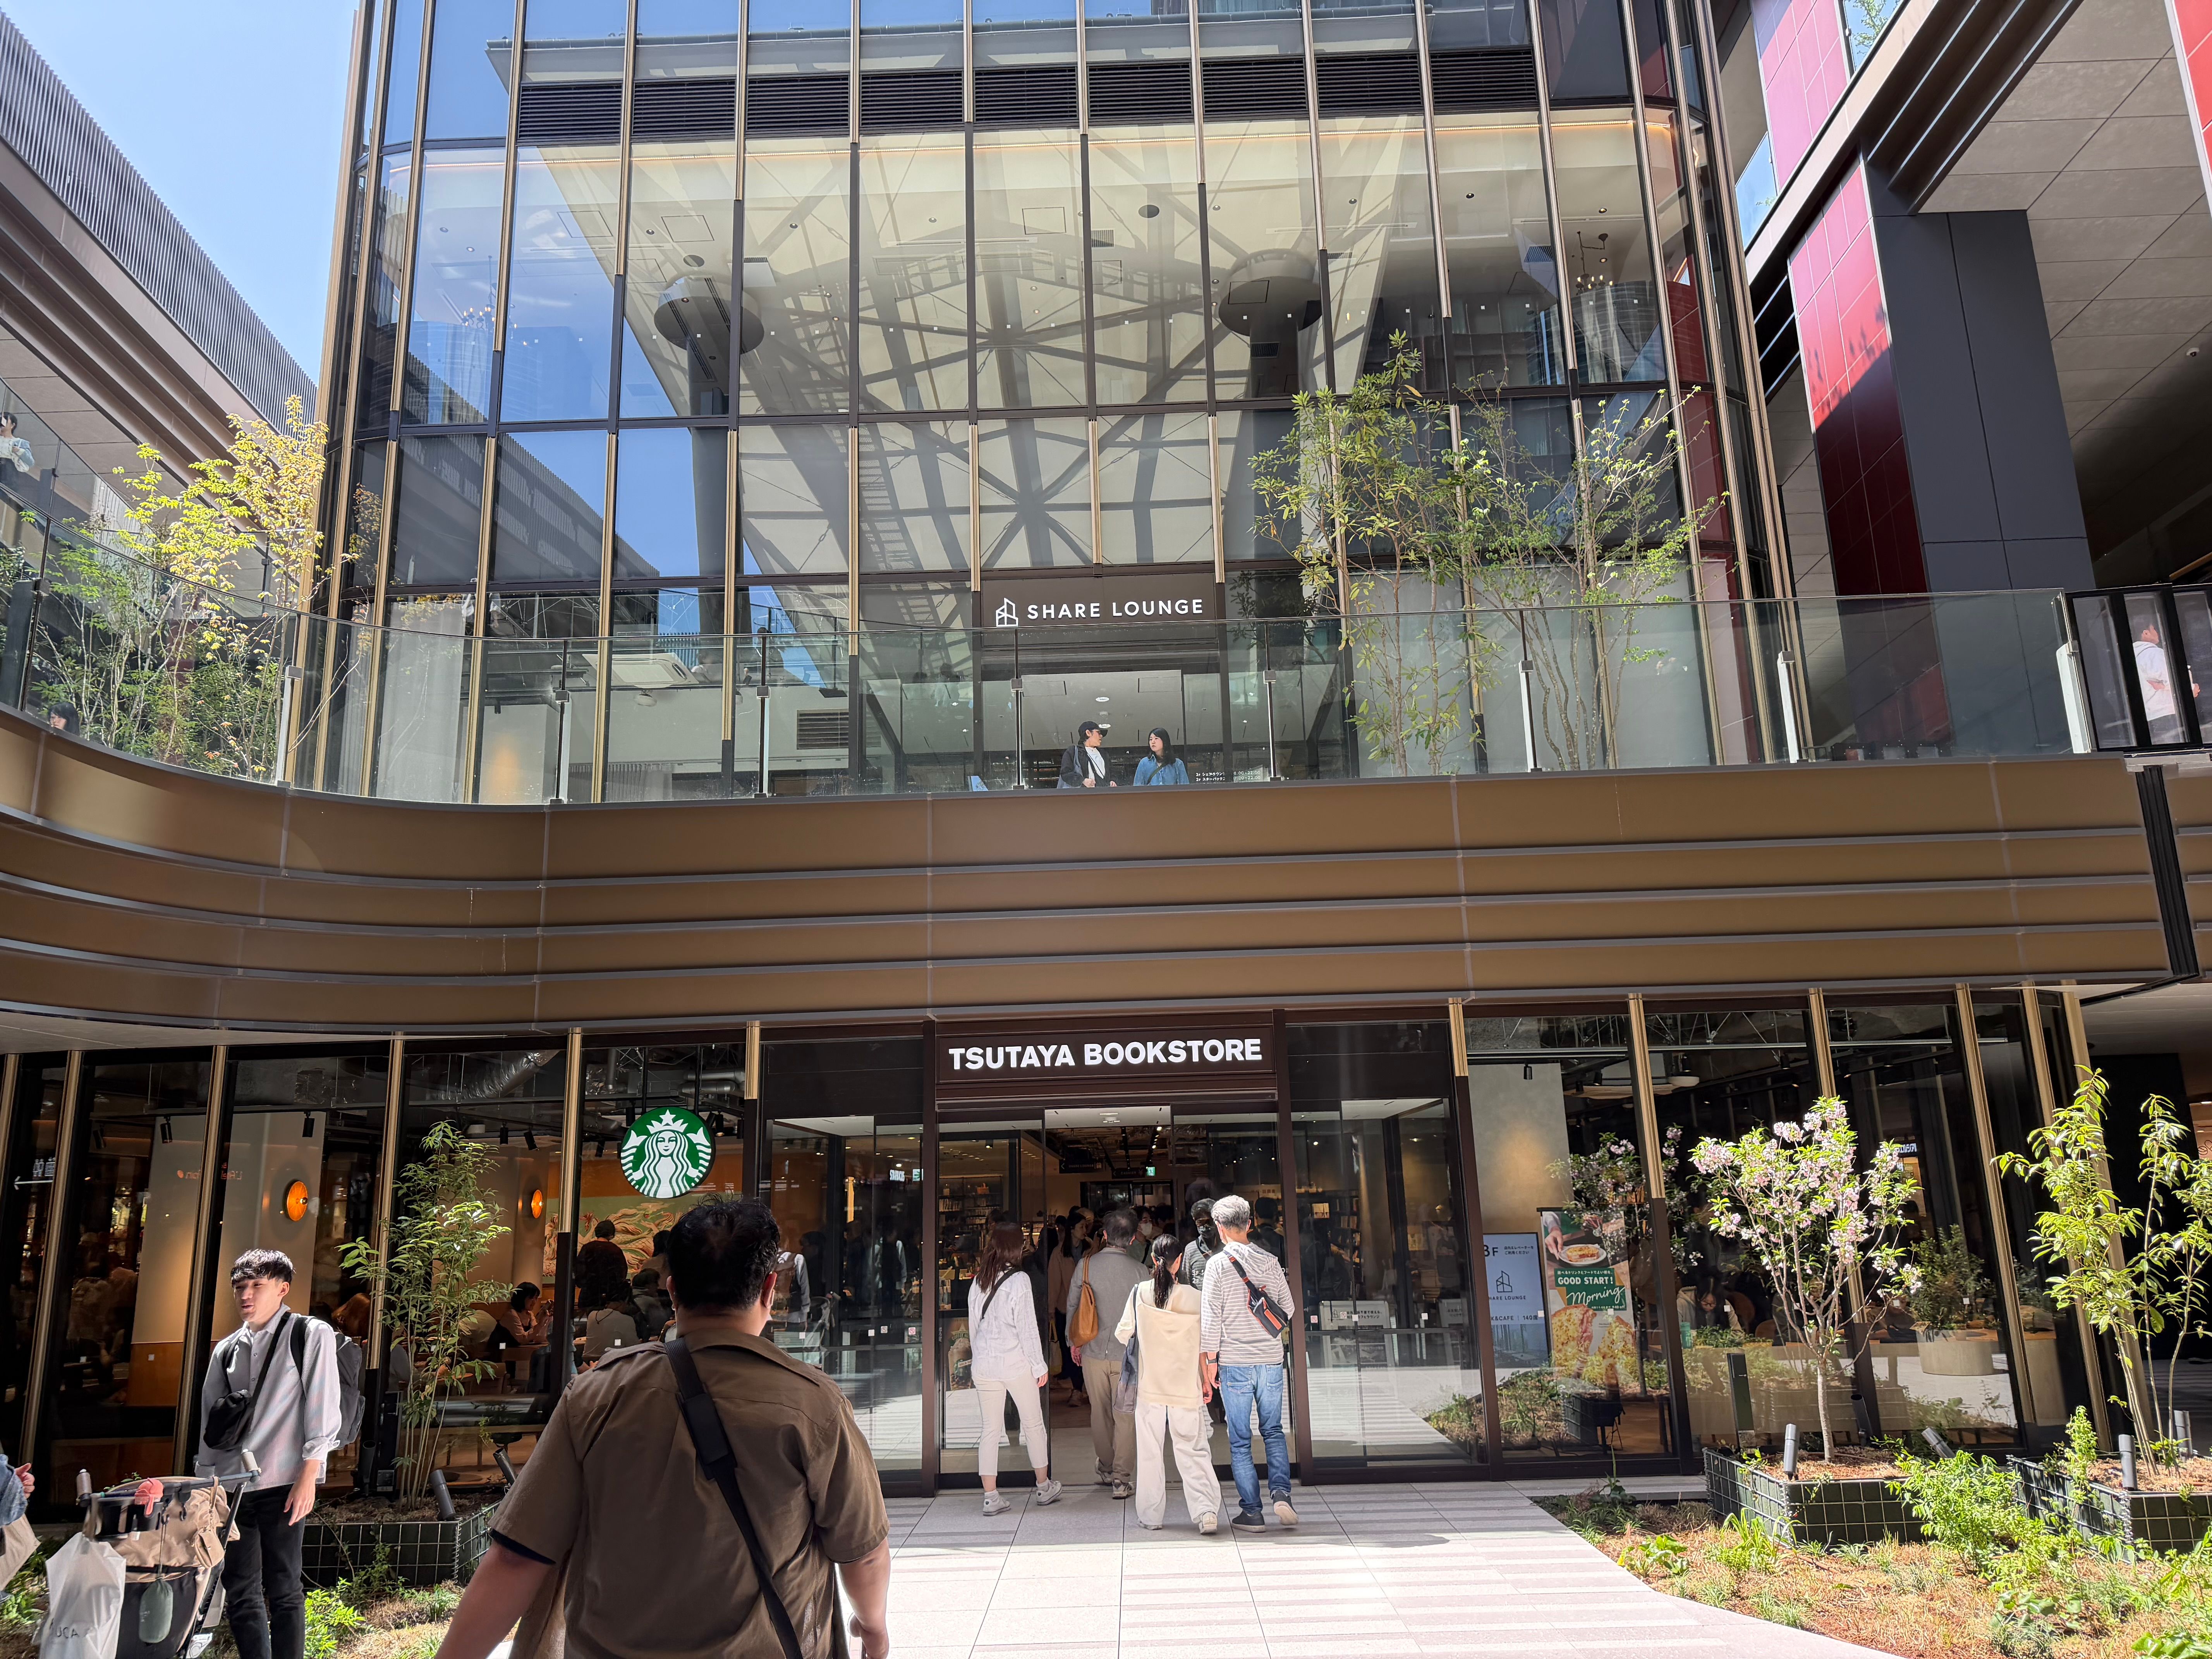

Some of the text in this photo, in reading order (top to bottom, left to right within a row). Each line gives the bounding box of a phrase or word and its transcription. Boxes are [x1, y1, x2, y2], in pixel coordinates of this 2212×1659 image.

[1027, 599, 1203, 620] SHARE LOUNGE
[949, 1038, 1262, 1070] TSUTAYA BOOKSTORE
[1566, 1286, 1625, 1305] Morning
